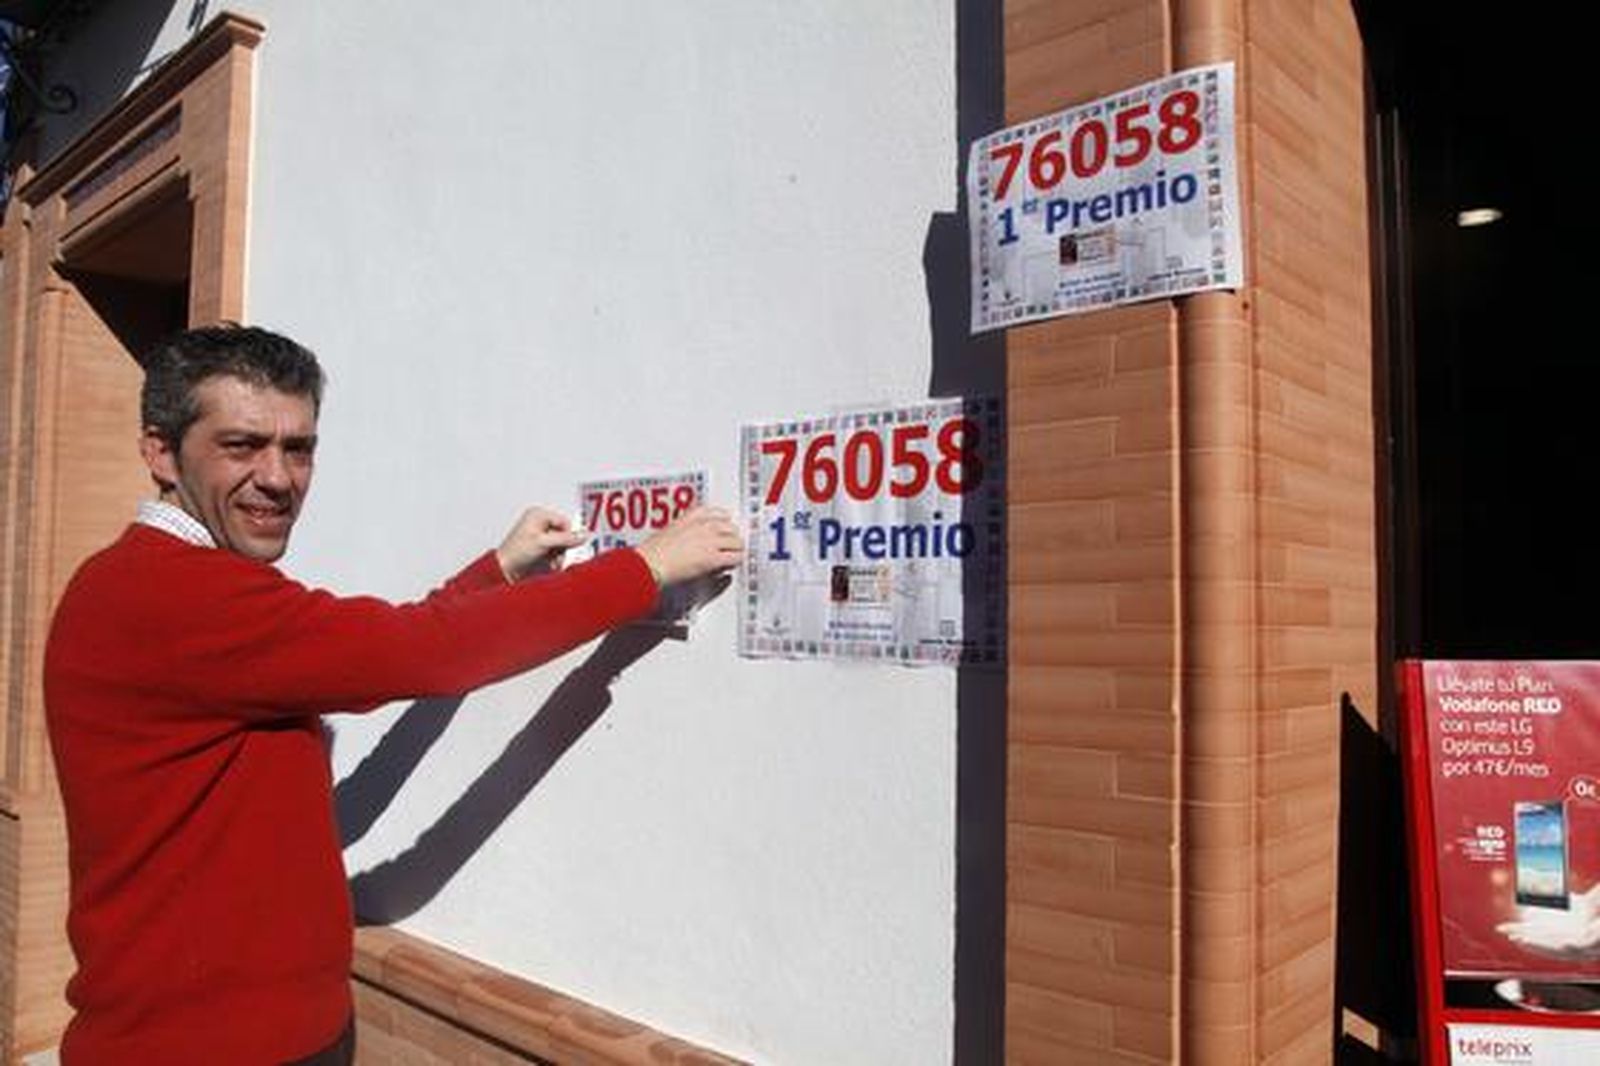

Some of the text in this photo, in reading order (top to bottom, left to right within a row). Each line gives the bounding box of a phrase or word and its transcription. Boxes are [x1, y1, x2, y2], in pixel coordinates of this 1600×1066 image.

[990, 90, 1203, 203] 76058
[1046, 170, 1199, 234] Premio
[761, 418, 984, 507] 76058
[818, 511, 976, 560] Premio
[1517, 675, 1554, 693] Plan
[1439, 696, 1562, 714] Vodafone RED
[1440, 718, 1533, 735] con este LG
[1442, 738, 1511, 757] Optimus
[1442, 761, 1470, 777] por
